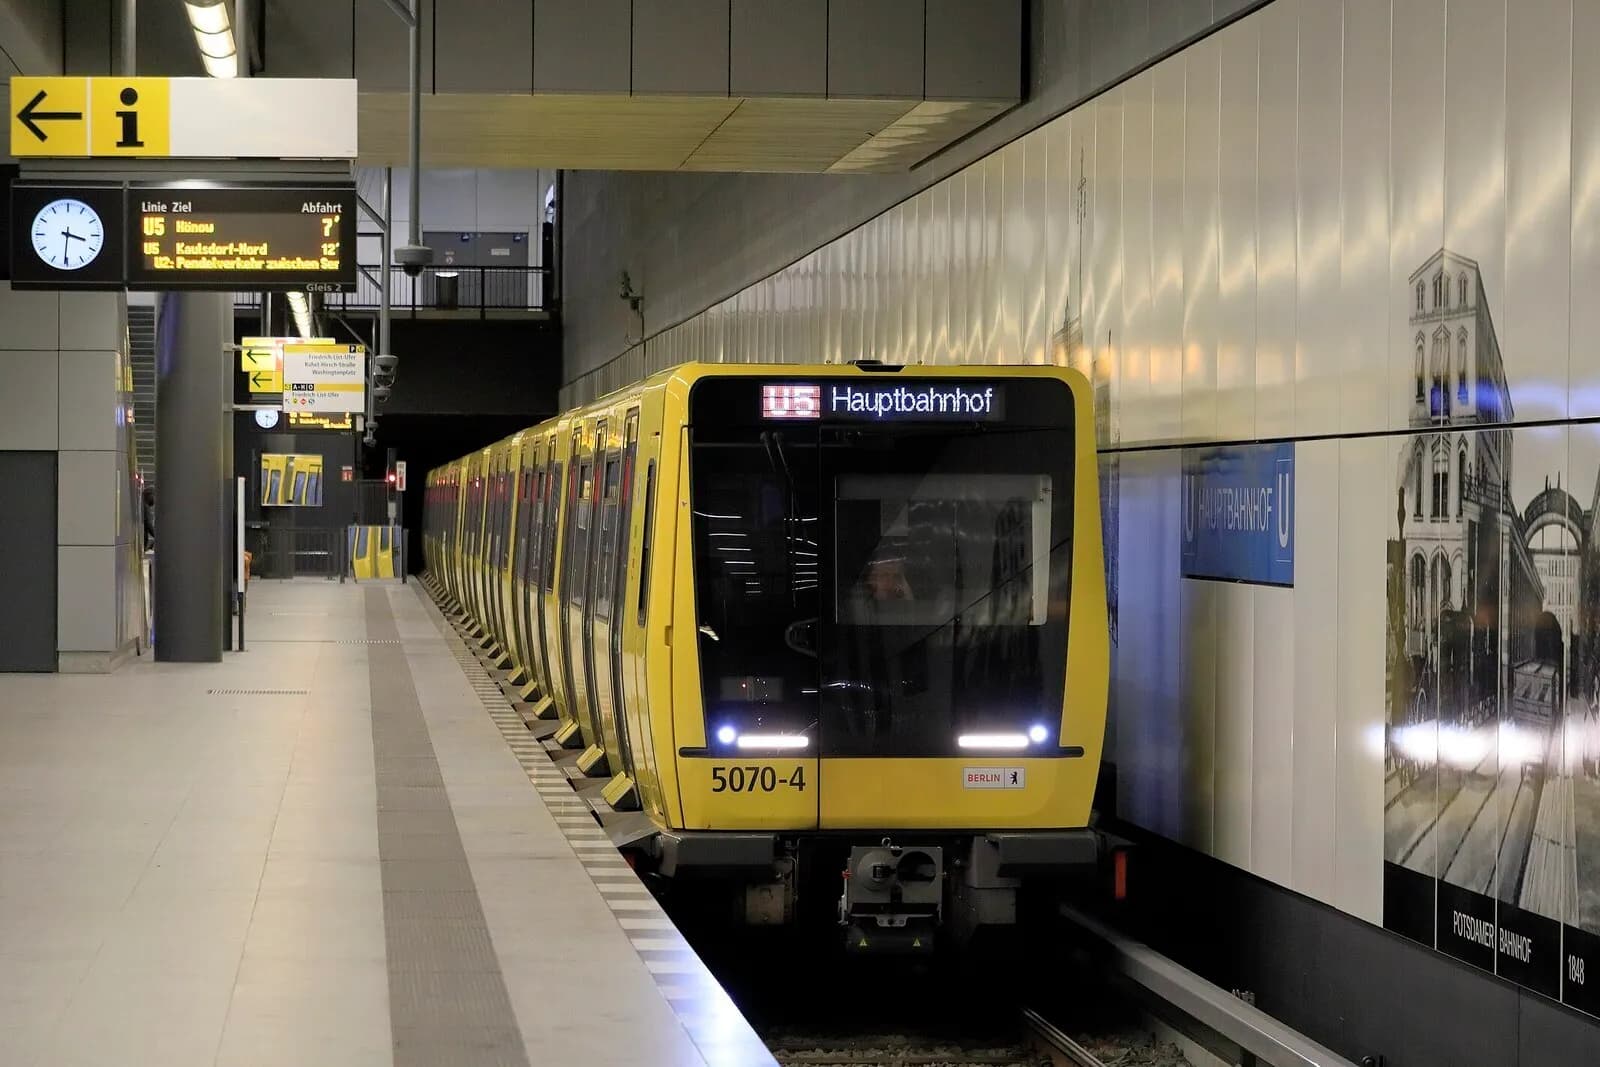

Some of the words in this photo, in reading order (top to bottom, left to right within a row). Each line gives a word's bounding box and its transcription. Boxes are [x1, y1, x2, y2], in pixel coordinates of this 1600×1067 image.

[141, 202, 167, 213] Linie
[172, 202, 192, 213] Ziel
[301, 202, 342, 213] Abfahrt
[143, 217, 165, 236] U5
[143, 242, 160, 255] U5
[175, 242, 268, 255] Kaulsdorf-Nord
[306, 283, 332, 292] Gleis
[335, 283, 342, 292] 2
[768, 387, 815, 416] U5
[832, 387, 993, 416] Hauptbahnhof
[1185, 474, 1194, 543] U
[1198, 487, 1273, 532] HAUPTBAHNHOF
[1278, 472, 1289, 549] U
[712, 766, 806, 792] 5070-4
[967, 772, 1001, 784] BERLIN
[1453, 910, 1495, 950] POTSDAMER
[1499, 927, 1532, 964] BAHNHOF
[1567, 954, 1585, 985] 1848
